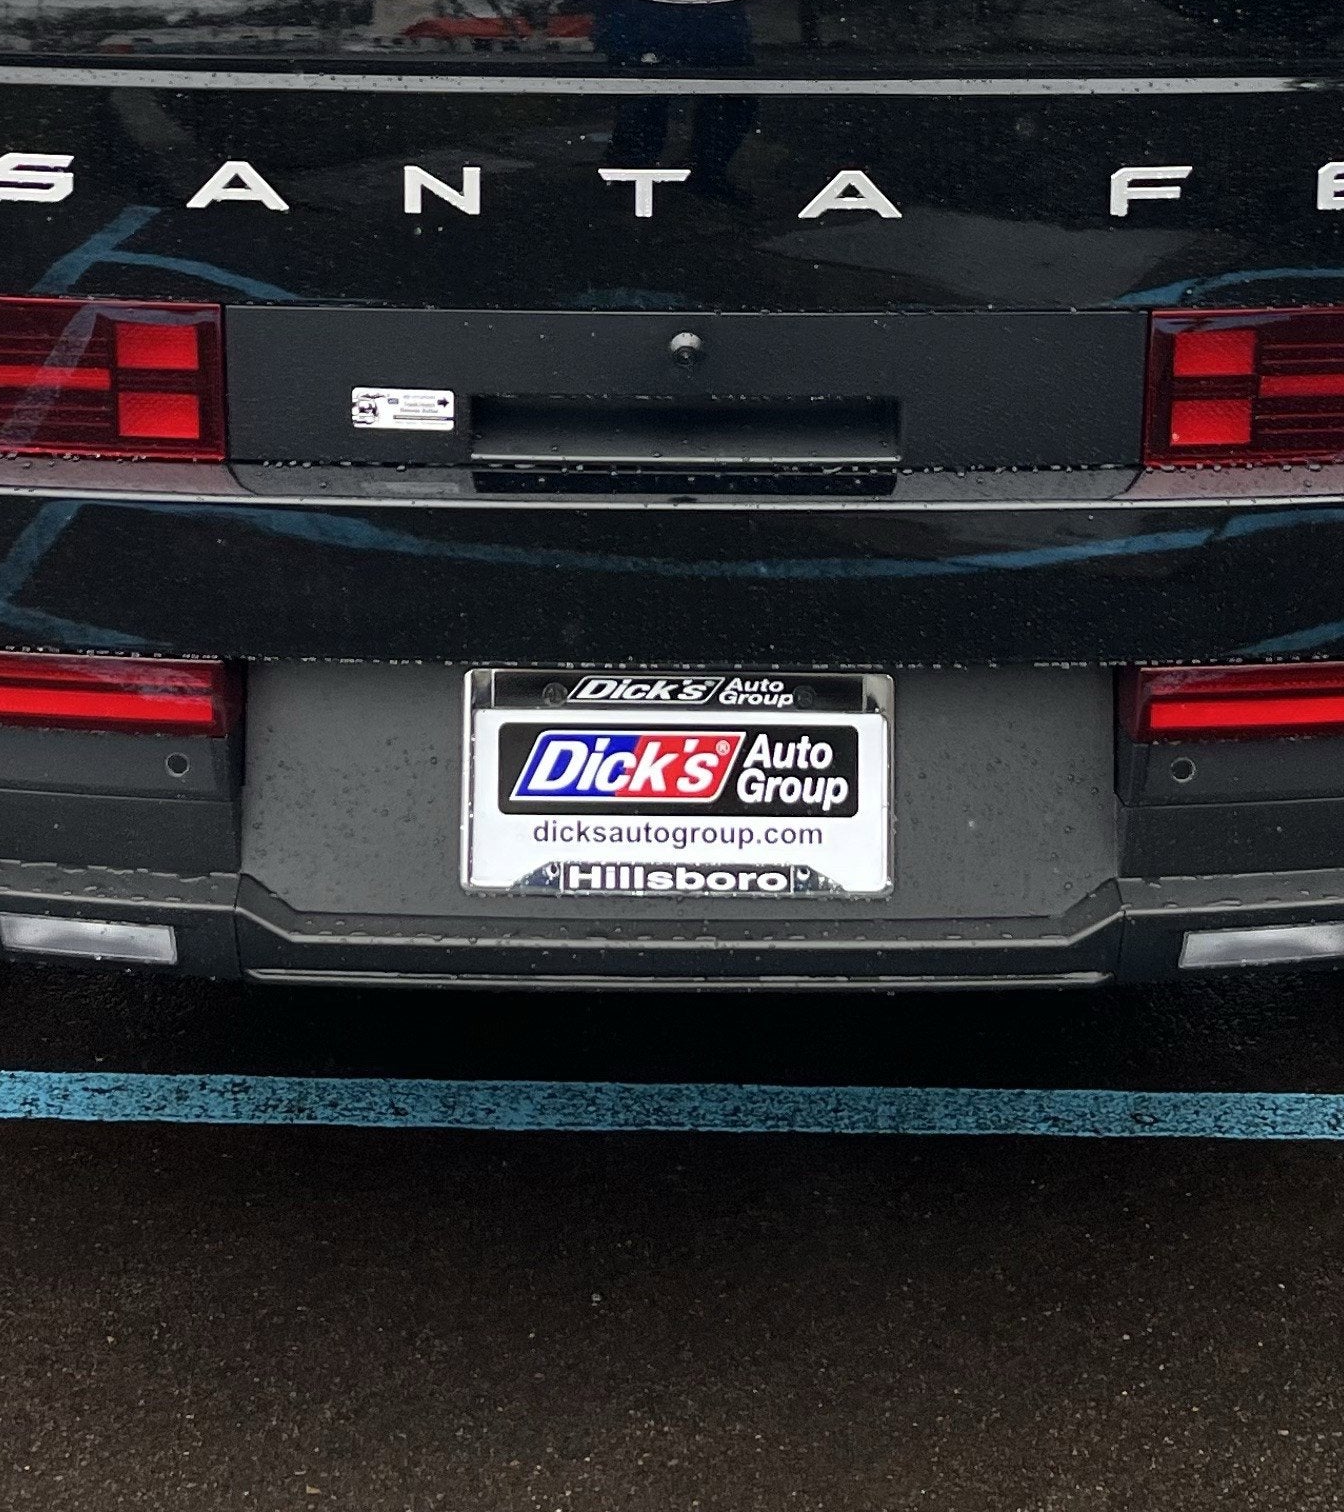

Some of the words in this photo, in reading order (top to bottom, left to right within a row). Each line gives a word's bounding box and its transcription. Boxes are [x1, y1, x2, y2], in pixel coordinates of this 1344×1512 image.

[575, 678, 708, 701] Dick's
[727, 677, 785, 693] Auto
[718, 691, 794, 708] Group
[528, 737, 719, 793] Dick's
[743, 733, 833, 770] Auto
[736, 769, 849, 811] Group
[533, 819, 823, 849] dicksautogroup.com
[569, 866, 789, 892] Hillsboro
